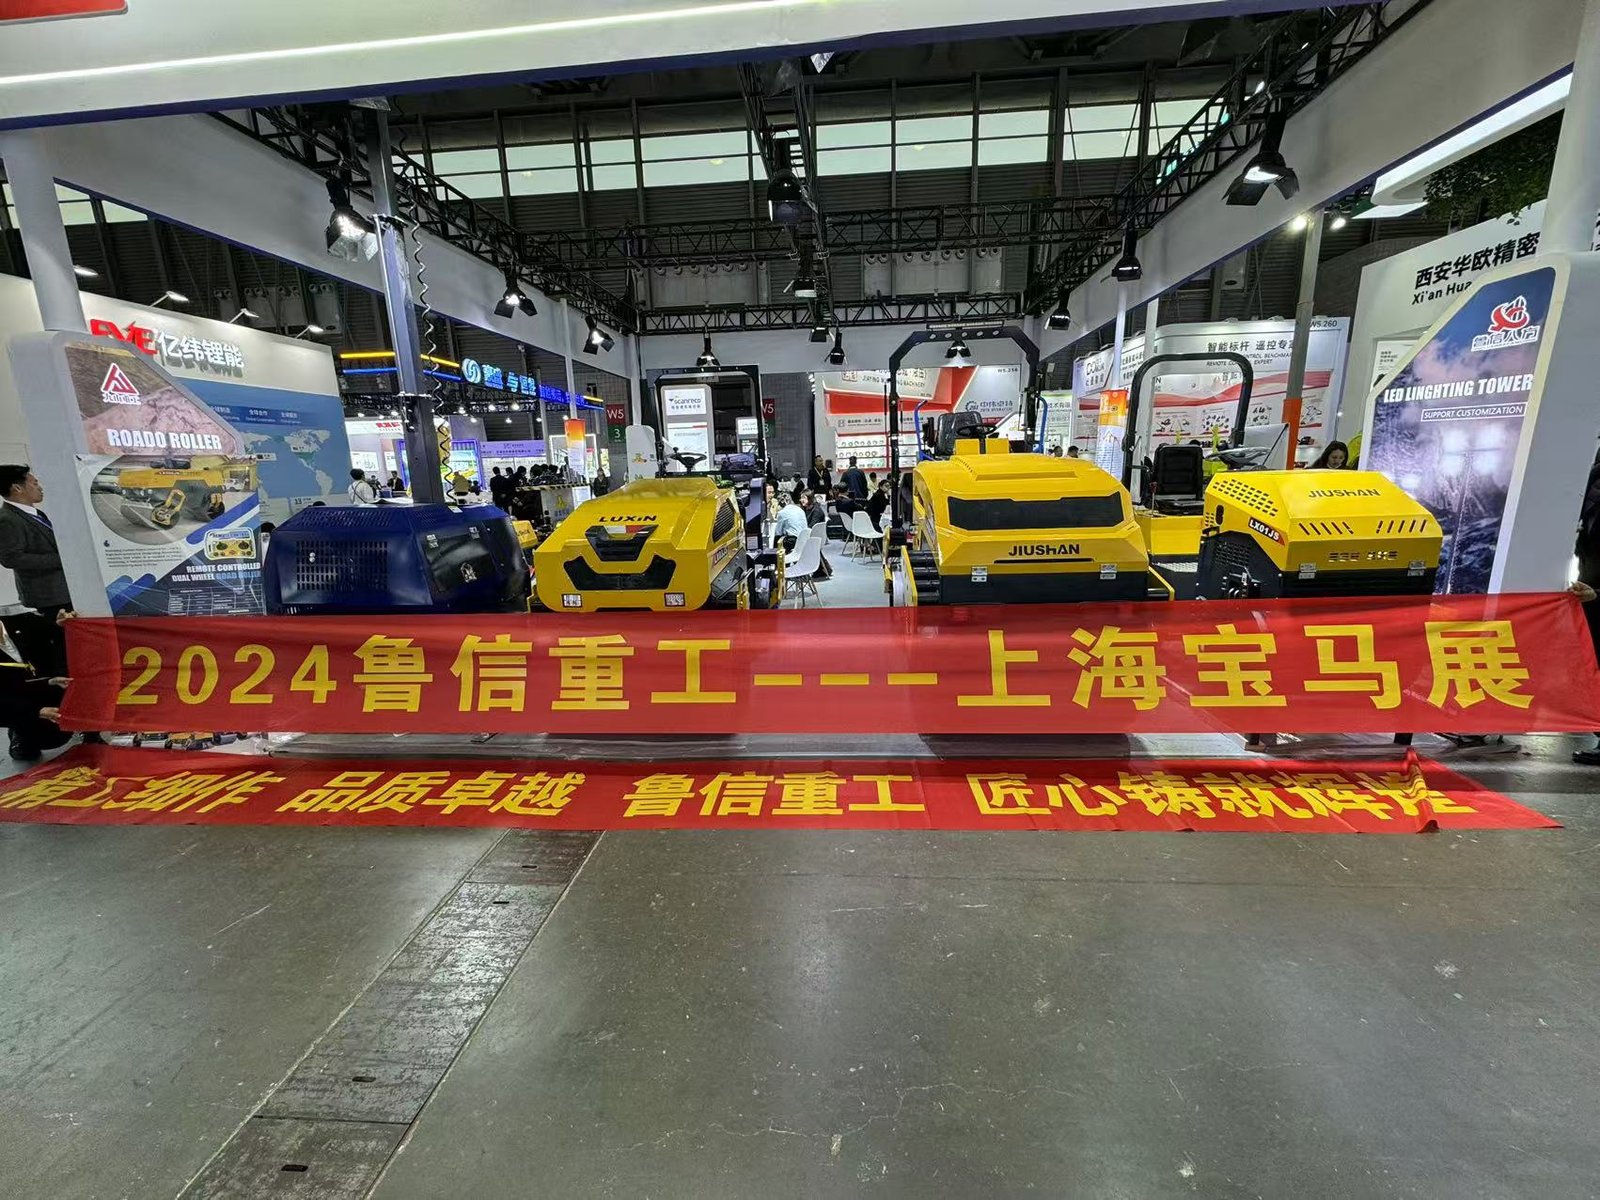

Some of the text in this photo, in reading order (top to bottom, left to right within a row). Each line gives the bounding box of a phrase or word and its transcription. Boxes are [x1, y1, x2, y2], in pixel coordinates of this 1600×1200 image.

[1414, 232, 1541, 289] 西安华欧精密
[1411, 289, 1443, 305] Xi'an
[157, 331, 245, 368] 亿纬锂能
[1384, 373, 1534, 403] LED LINGHTING TOWER
[607, 408, 624, 419] W5
[1424, 405, 1523, 419] SUPPORT CUSTOMIZATION
[107, 428, 222, 450] ROADO ROLLER
[614, 428, 621, 437] 3
[1249, 519, 1280, 541] LX01JS
[172, 574, 191, 582] DUAL
[191, 573, 214, 581] WHEEL
[186, 563, 261, 573] REMOTE CONTROLLED
[276, 770, 586, 816] 品质卓越
[622, 771, 925, 817] 鲁信重工
